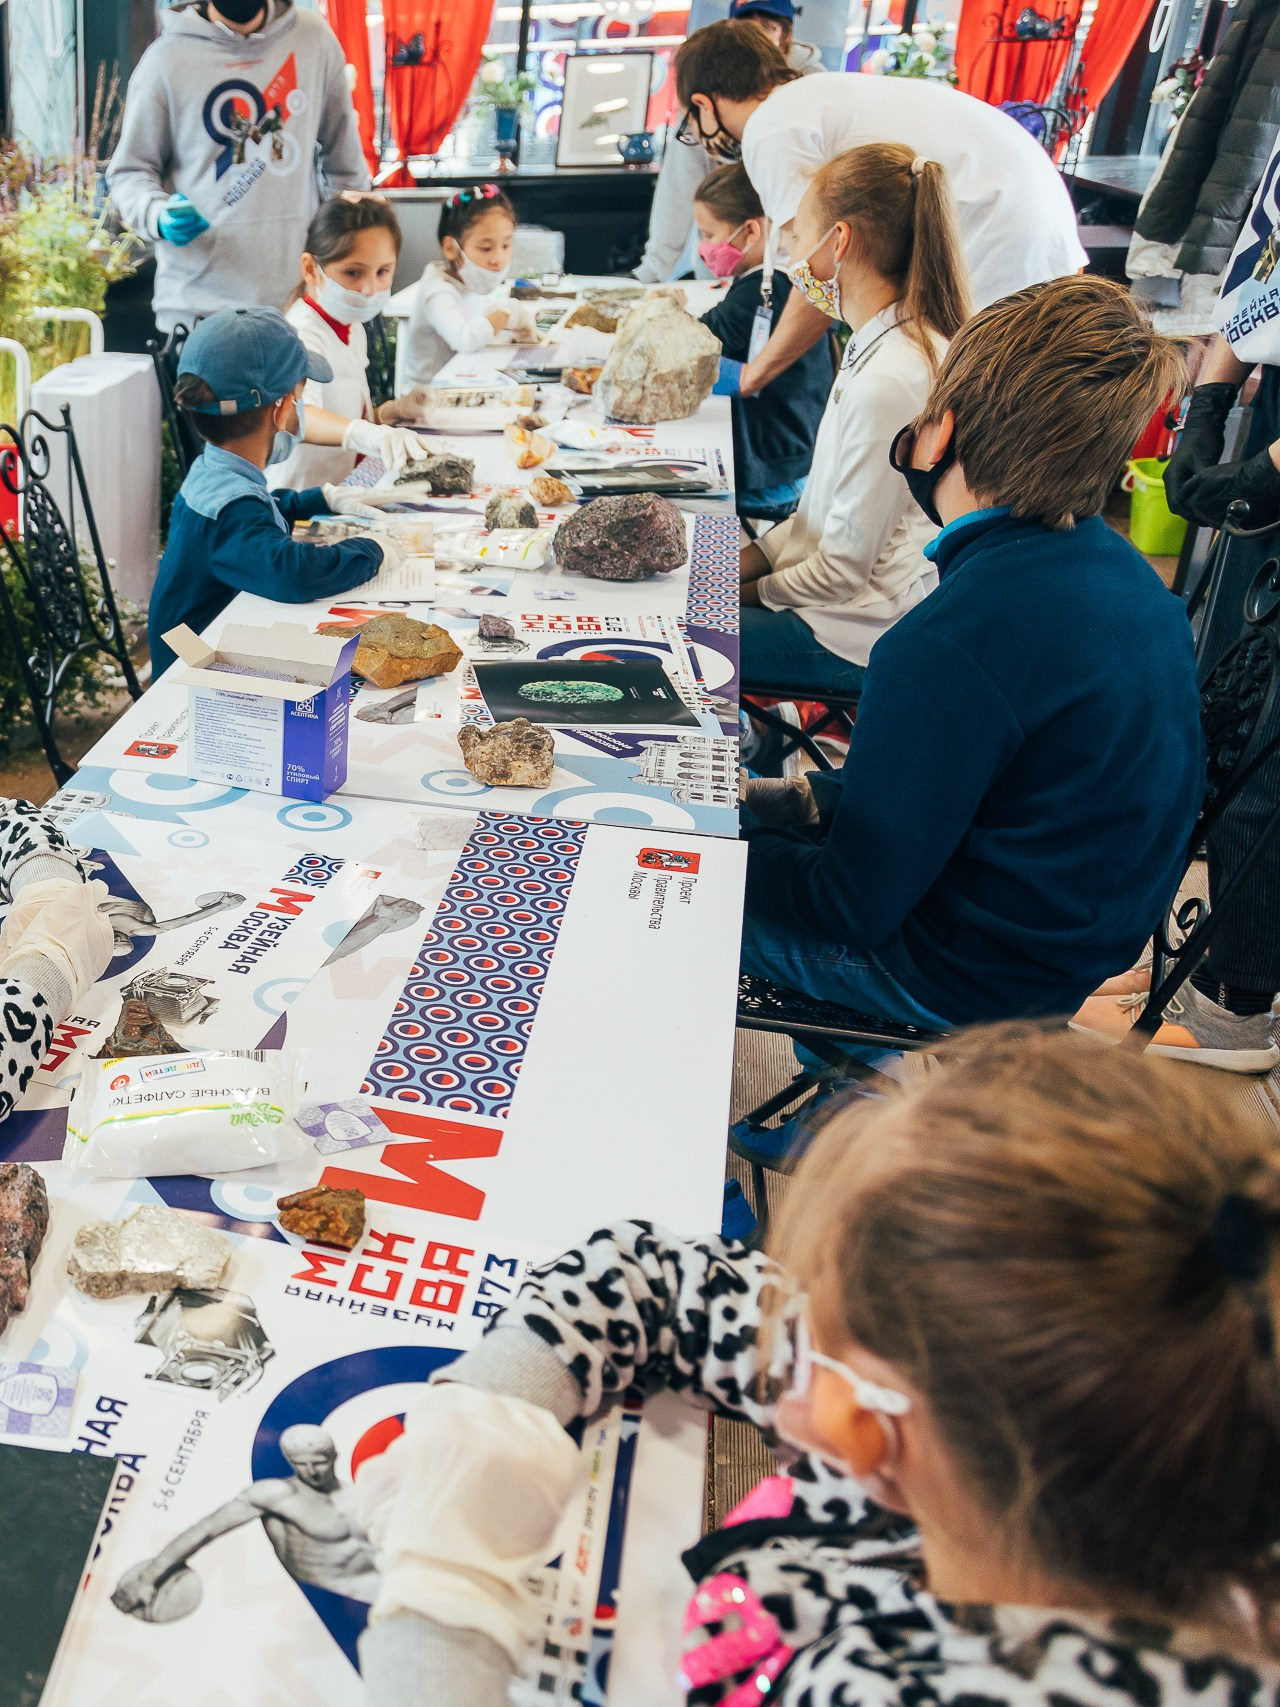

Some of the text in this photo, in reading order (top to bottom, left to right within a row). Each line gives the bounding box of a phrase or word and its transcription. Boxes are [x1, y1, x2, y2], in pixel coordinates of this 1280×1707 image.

[290, 710, 319, 721] АСЕПТИКА
[286, 763, 306, 773] 70%
[286, 771, 320, 781] этиловый
[286, 776, 310, 786] СПИРТ
[627, 871, 648, 900] Москвы
[678, 876, 698, 904] Проект
[648, 873, 673, 930] Правительства
[174, 935, 210, 966] СЕНТЯБРЯ
[145, 1064, 177, 1077] ДЕТЕЙ
[284, 1284, 456, 1332] МУЗЕЙНАЯ
[153, 1408, 211, 1513] 5-6 СЕНТЯБРЯ
